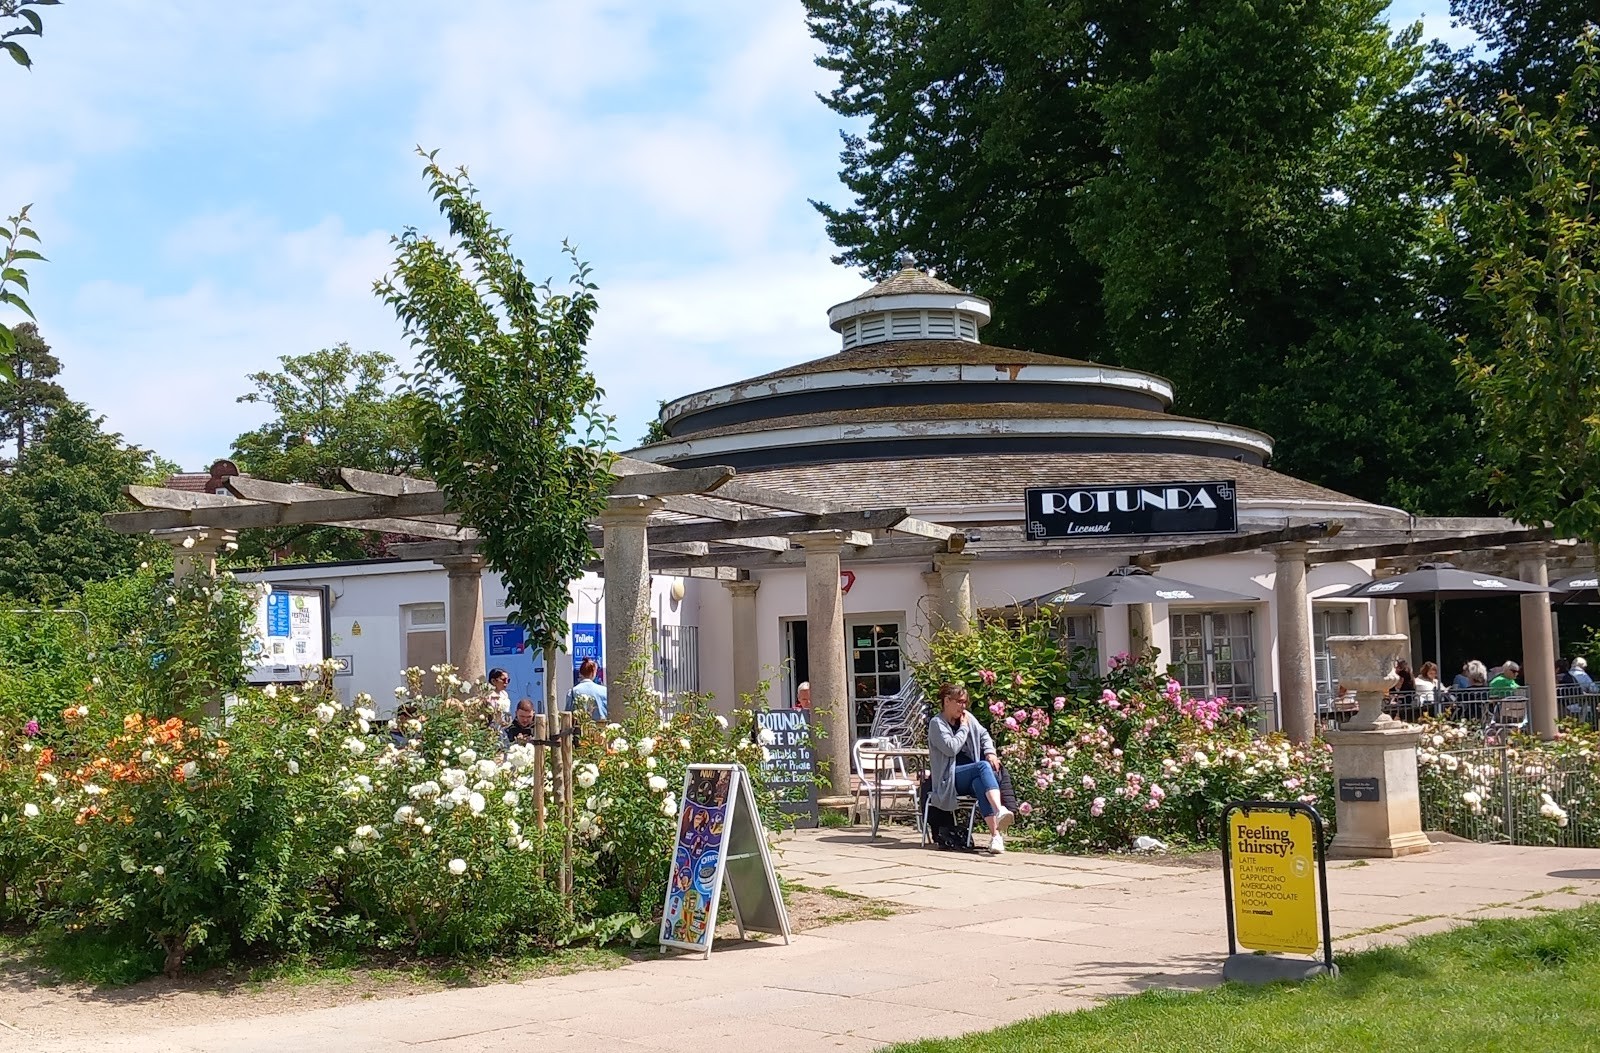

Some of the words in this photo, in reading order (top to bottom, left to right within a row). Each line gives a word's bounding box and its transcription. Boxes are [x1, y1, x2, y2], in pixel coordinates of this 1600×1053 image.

[1041, 487, 1217, 515] ROTUNDA
[1067, 521, 1111, 534] Licensed
[575, 633, 594, 643] Toilets
[757, 713, 808, 731] ROTUNDA
[798, 747, 810, 759] To
[1237, 825, 1290, 844] Feeling
[1238, 840, 1295, 858] thirsty?
[1255, 866, 1275, 874] WHITE
[1240, 874, 1286, 882] CAPPUCCINO
[1240, 883, 1282, 891] AMERICANO
[1255, 892, 1298, 900] CHOCOLATE
[1241, 899, 1268, 907] MOCHA
